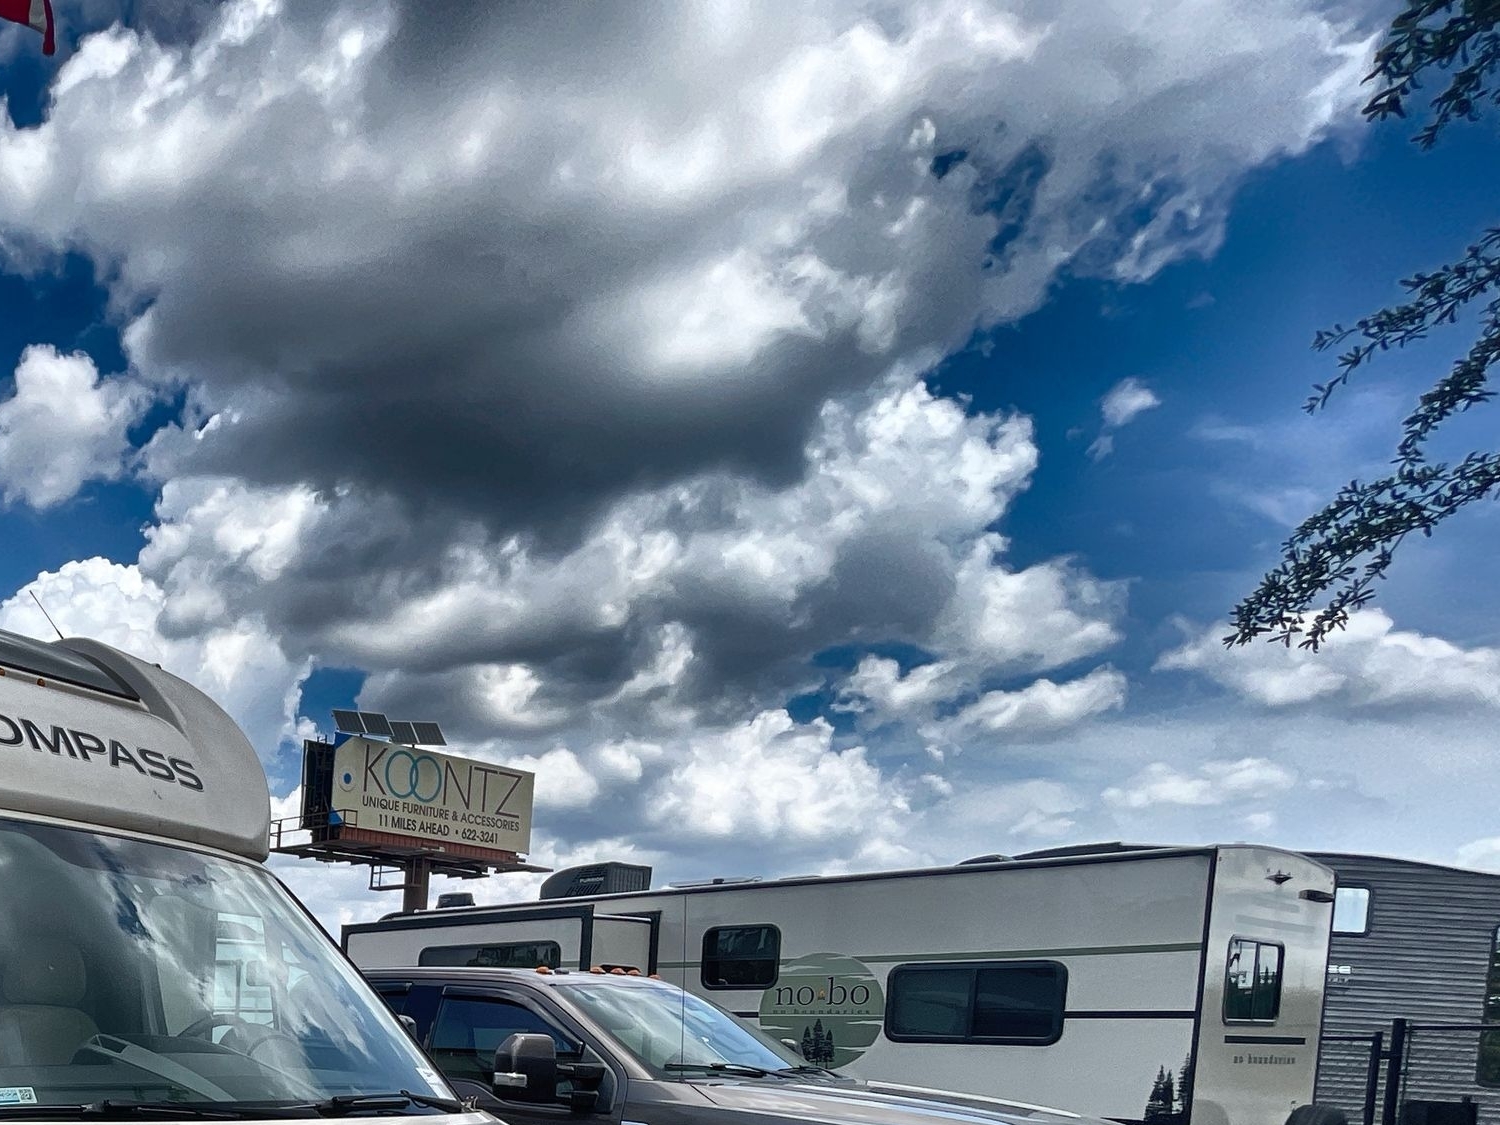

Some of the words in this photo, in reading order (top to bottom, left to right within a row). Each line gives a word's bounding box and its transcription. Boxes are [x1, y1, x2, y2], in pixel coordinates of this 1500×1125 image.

[363, 744, 523, 818] KOONTZ
[362, 795, 400, 812] UNIQUE
[402, 801, 449, 820] FURNITURE
[451, 811, 458, 821] &
[460, 812, 520, 832] ACCESSORIES
[379, 813, 388, 827] 11
[391, 815, 417, 832] MILES
[418, 820, 450, 836] AHEAD
[461, 828, 498, 844] 622-3241
